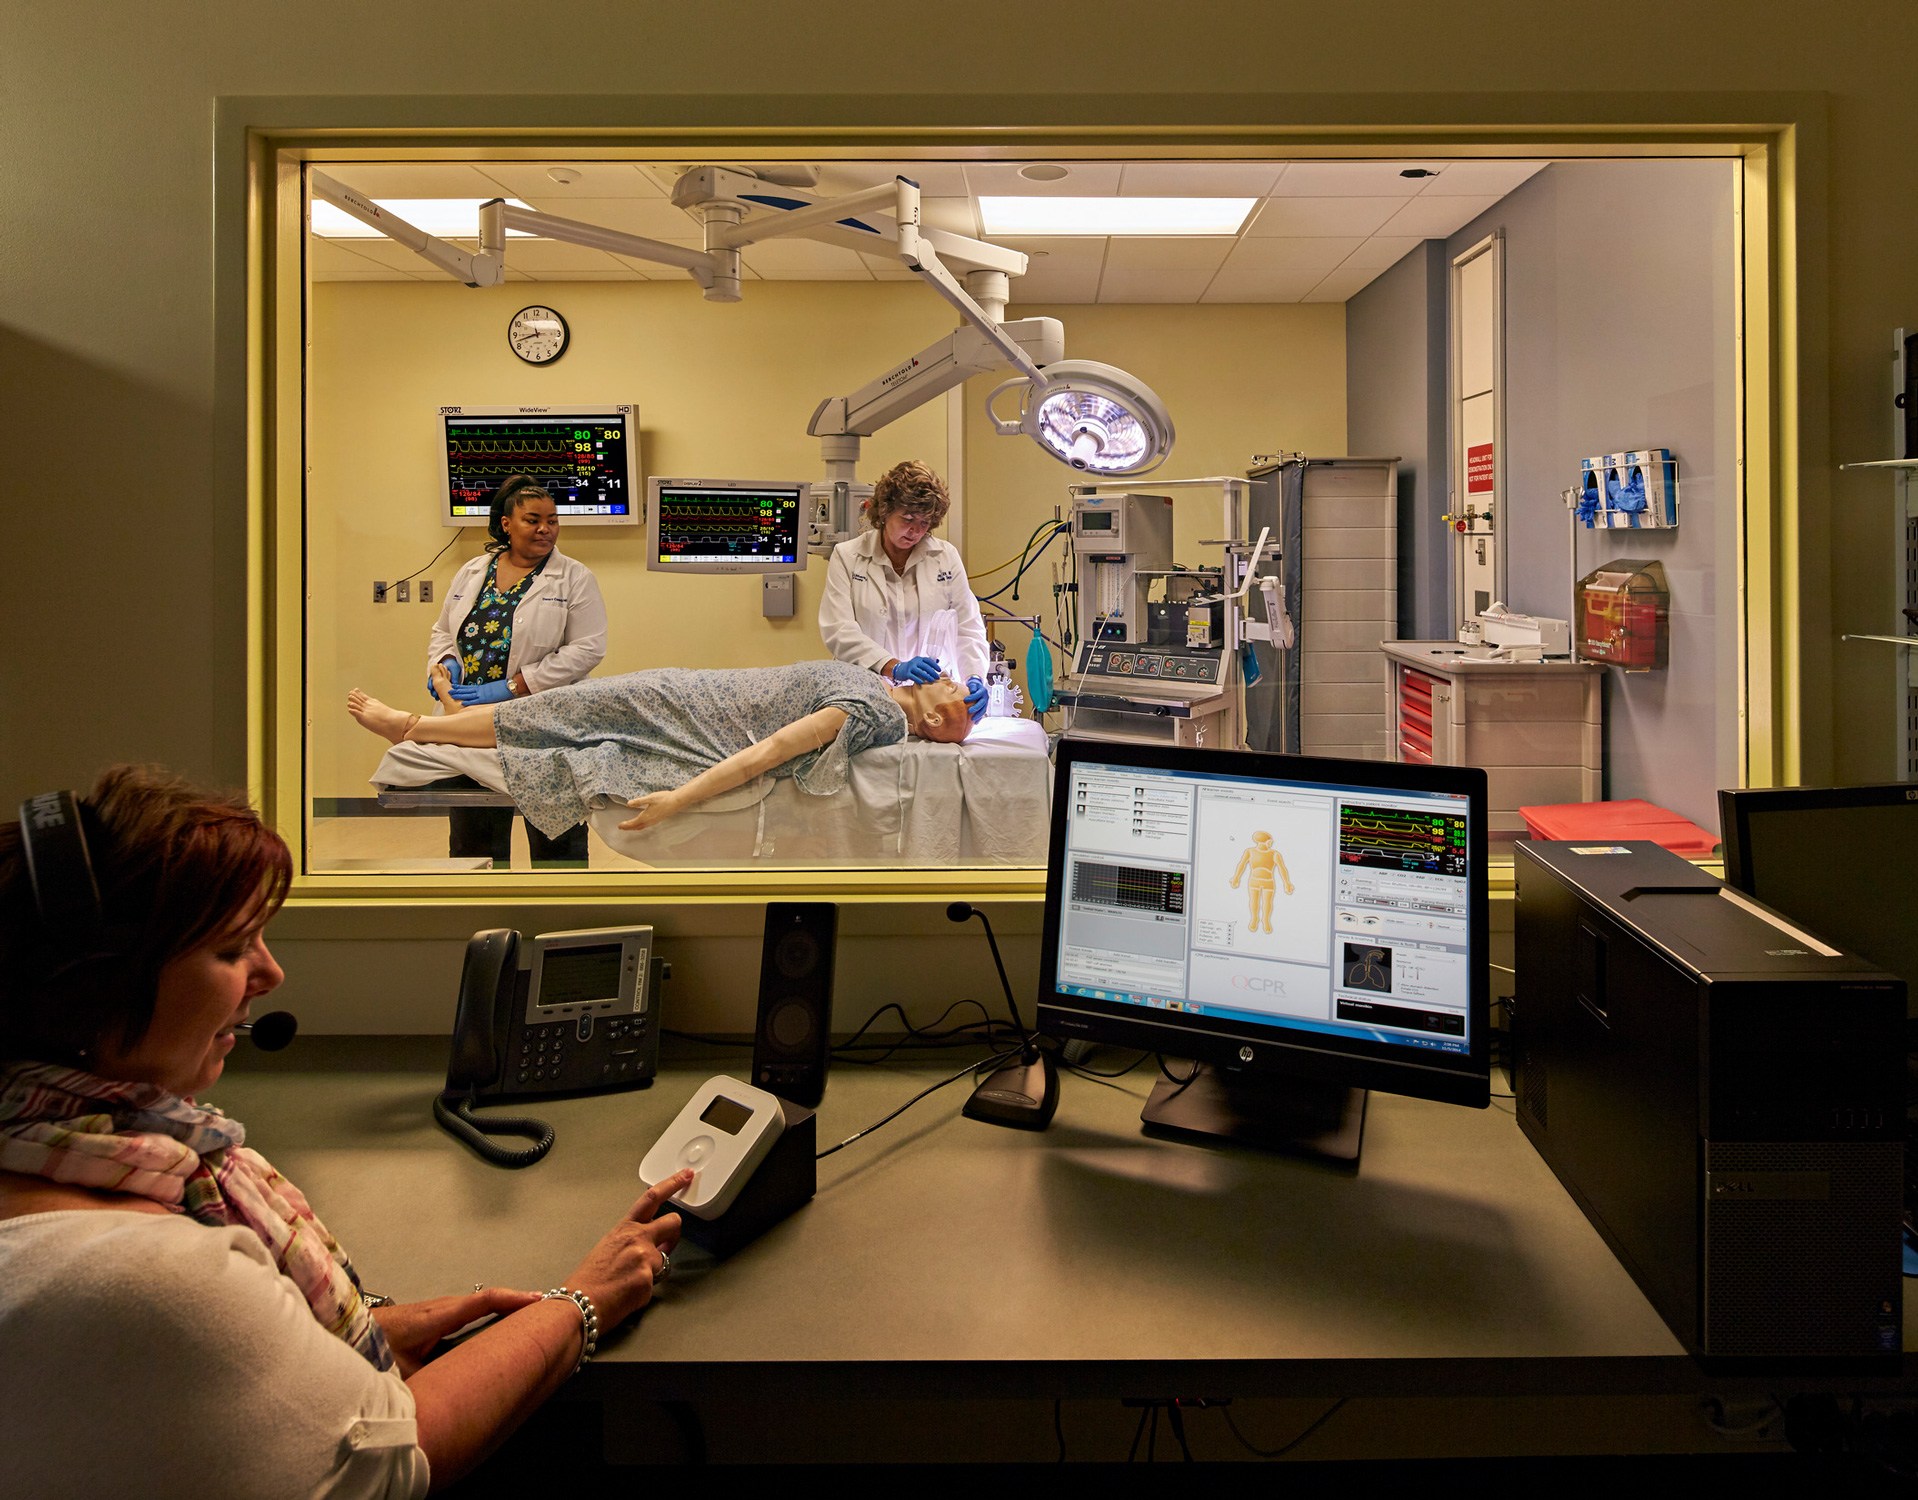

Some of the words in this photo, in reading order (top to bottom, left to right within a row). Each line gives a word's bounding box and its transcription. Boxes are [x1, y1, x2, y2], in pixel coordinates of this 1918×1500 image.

[882, 365, 912, 386] BERCHTOLD
[574, 430, 591, 440] 80
[604, 430, 620, 440] 80
[574, 442, 592, 452] 98
[607, 479, 621, 488] 11
[1240, 1046, 1253, 1062] hp
